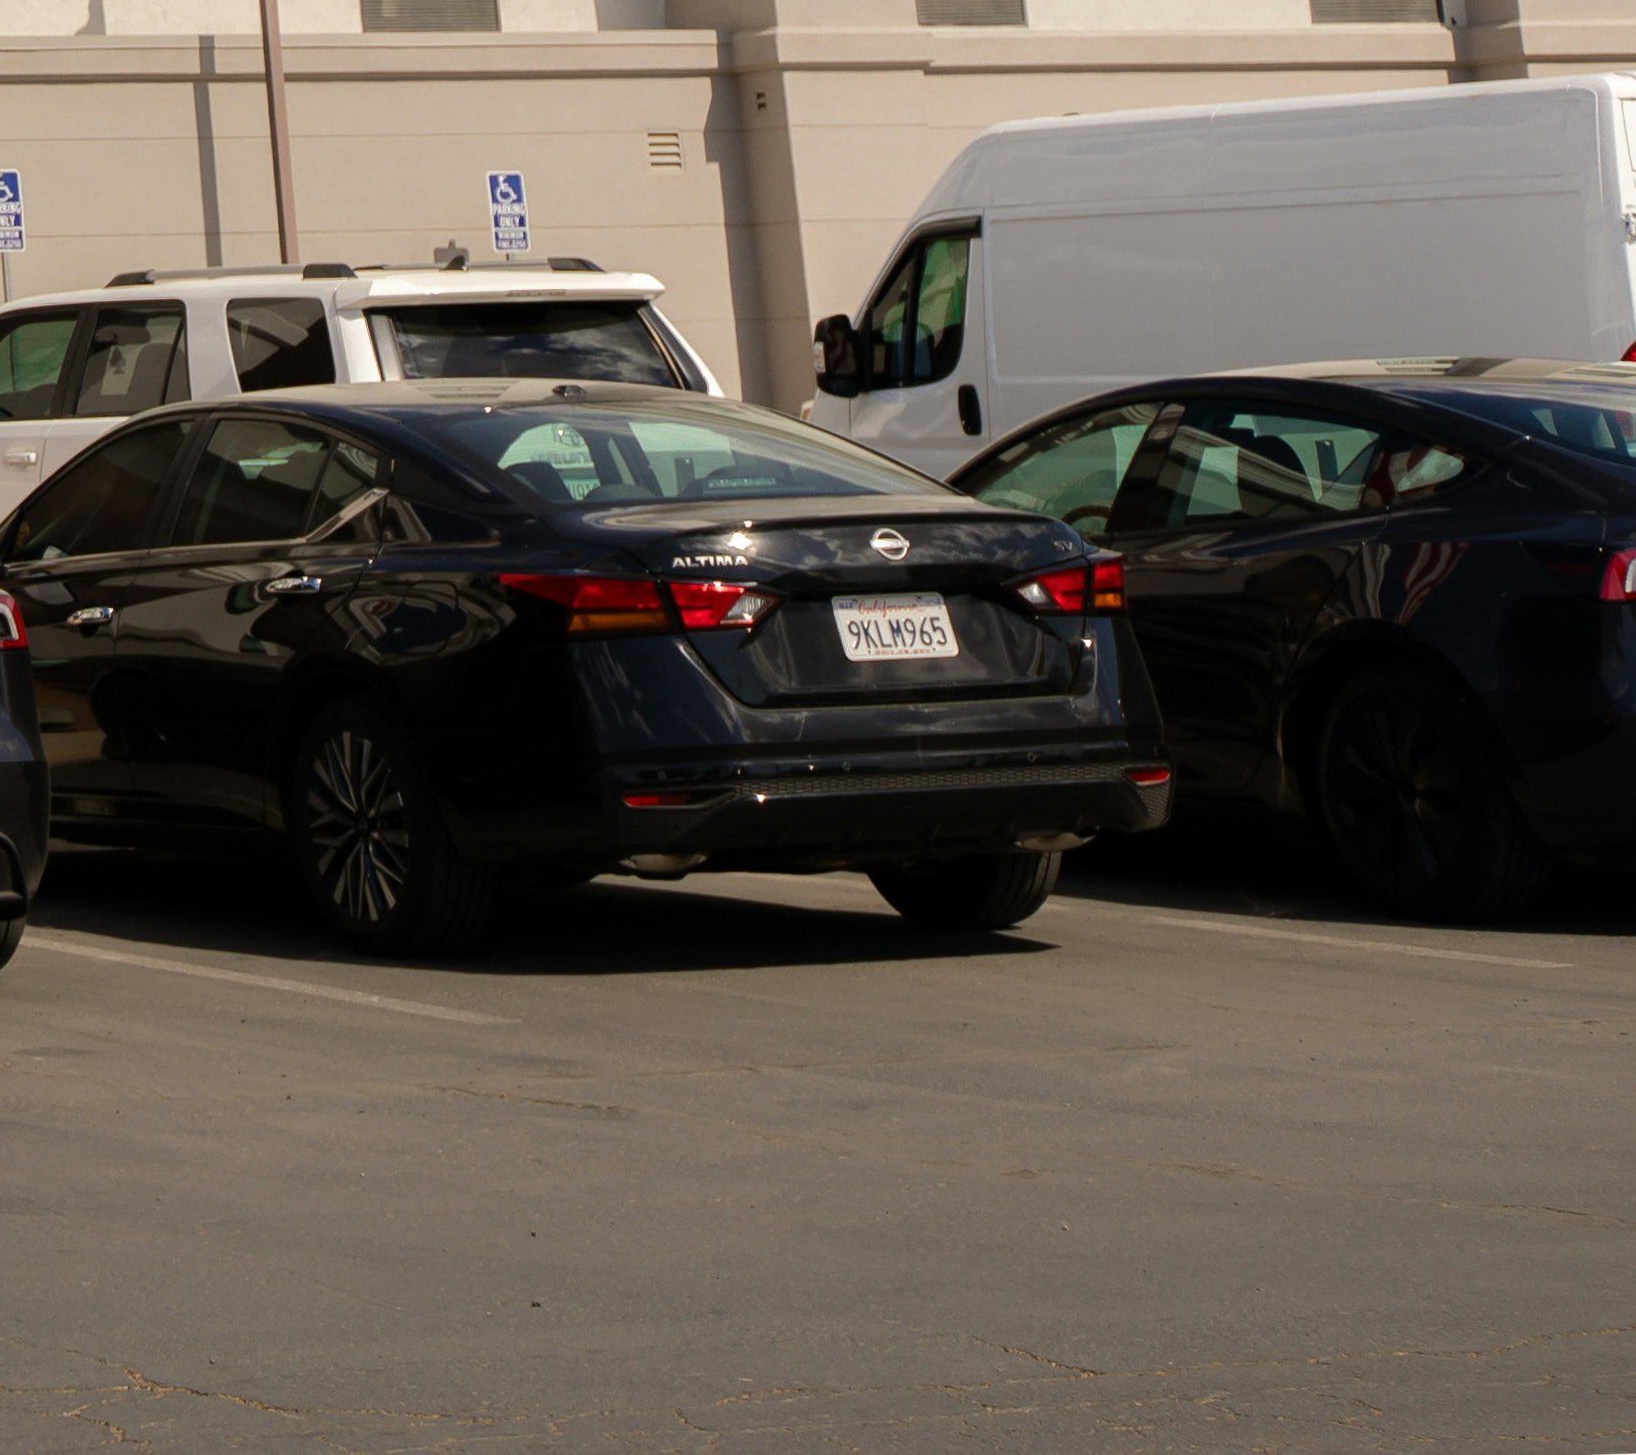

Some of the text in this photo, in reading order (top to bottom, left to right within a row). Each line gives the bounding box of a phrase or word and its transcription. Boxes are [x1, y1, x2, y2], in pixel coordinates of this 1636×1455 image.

[492, 203, 525, 215] PARKING
[499, 215, 520, 227] ONLY
[672, 555, 748, 568] ALTIMA
[848, 617, 947, 649] 9KLM965
